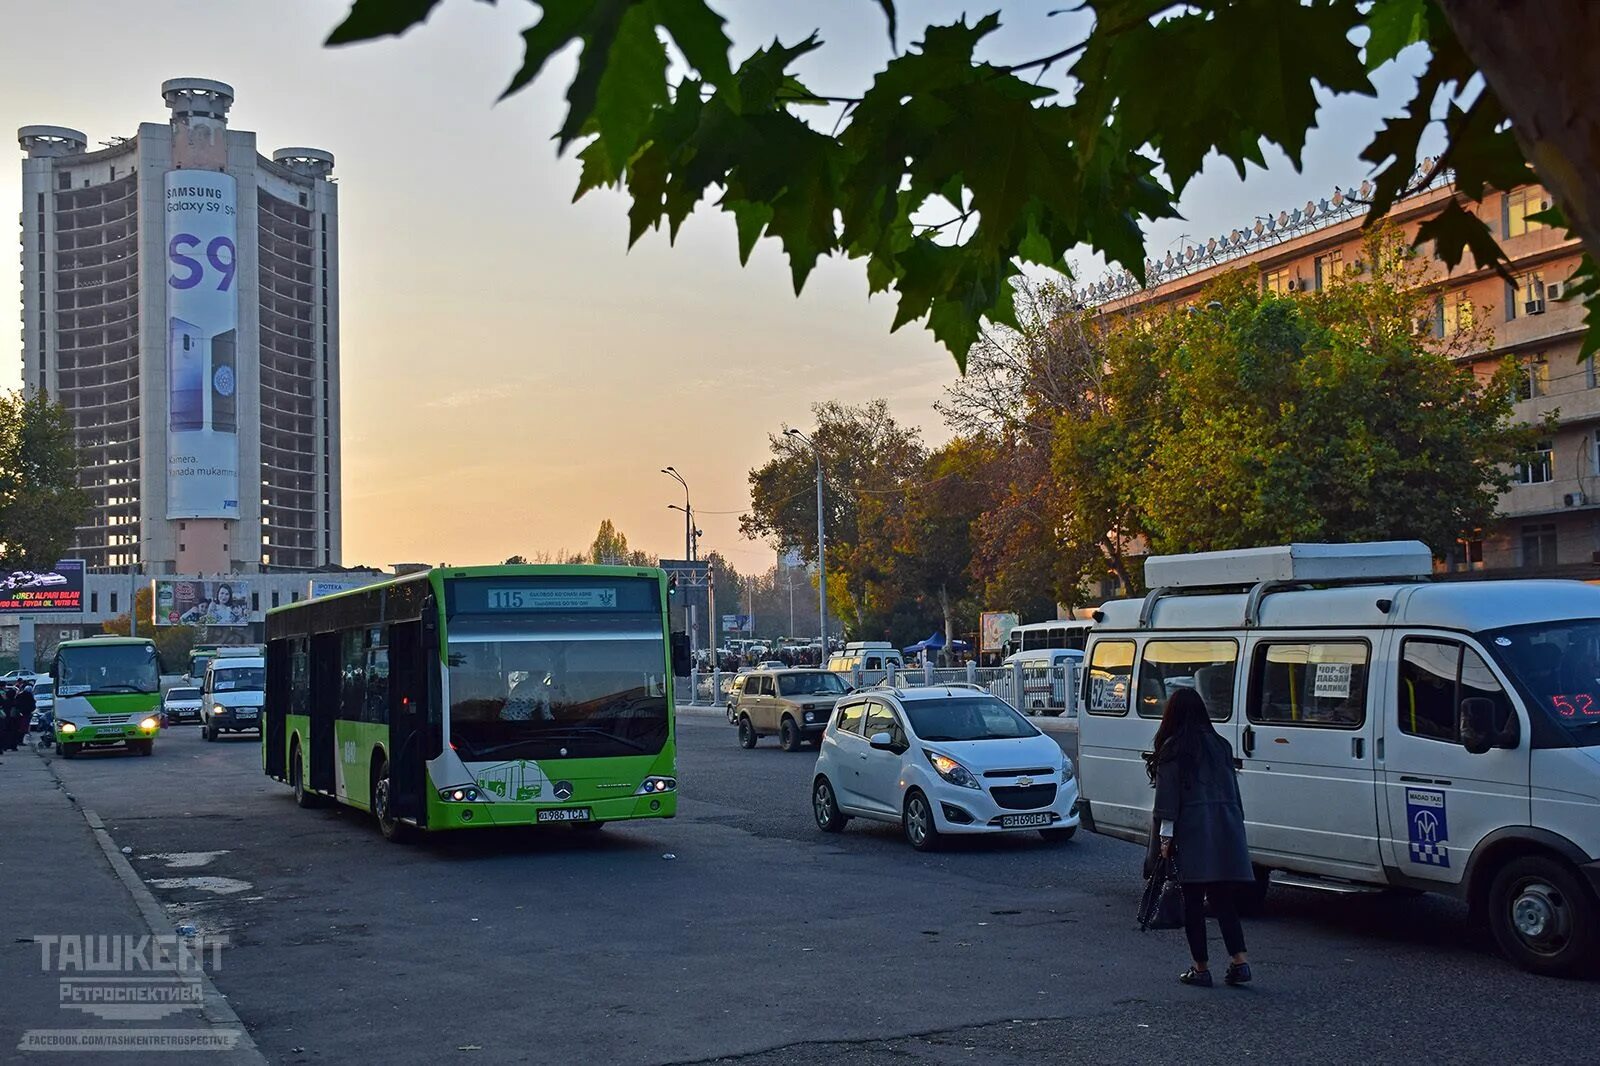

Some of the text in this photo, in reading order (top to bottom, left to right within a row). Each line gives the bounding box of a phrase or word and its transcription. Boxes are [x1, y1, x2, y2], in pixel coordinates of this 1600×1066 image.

[167, 187, 222, 199] SAMSUNG
[167, 201, 204, 213] Galaxy
[206, 202, 220, 212] S9
[168, 233, 236, 292] S9
[494, 591, 523, 608] 115
[1092, 679, 1104, 708] 52
[1552, 694, 1600, 716] 52
[1409, 793, 1429, 801] MADAD
[549, 810, 565, 820] 986
